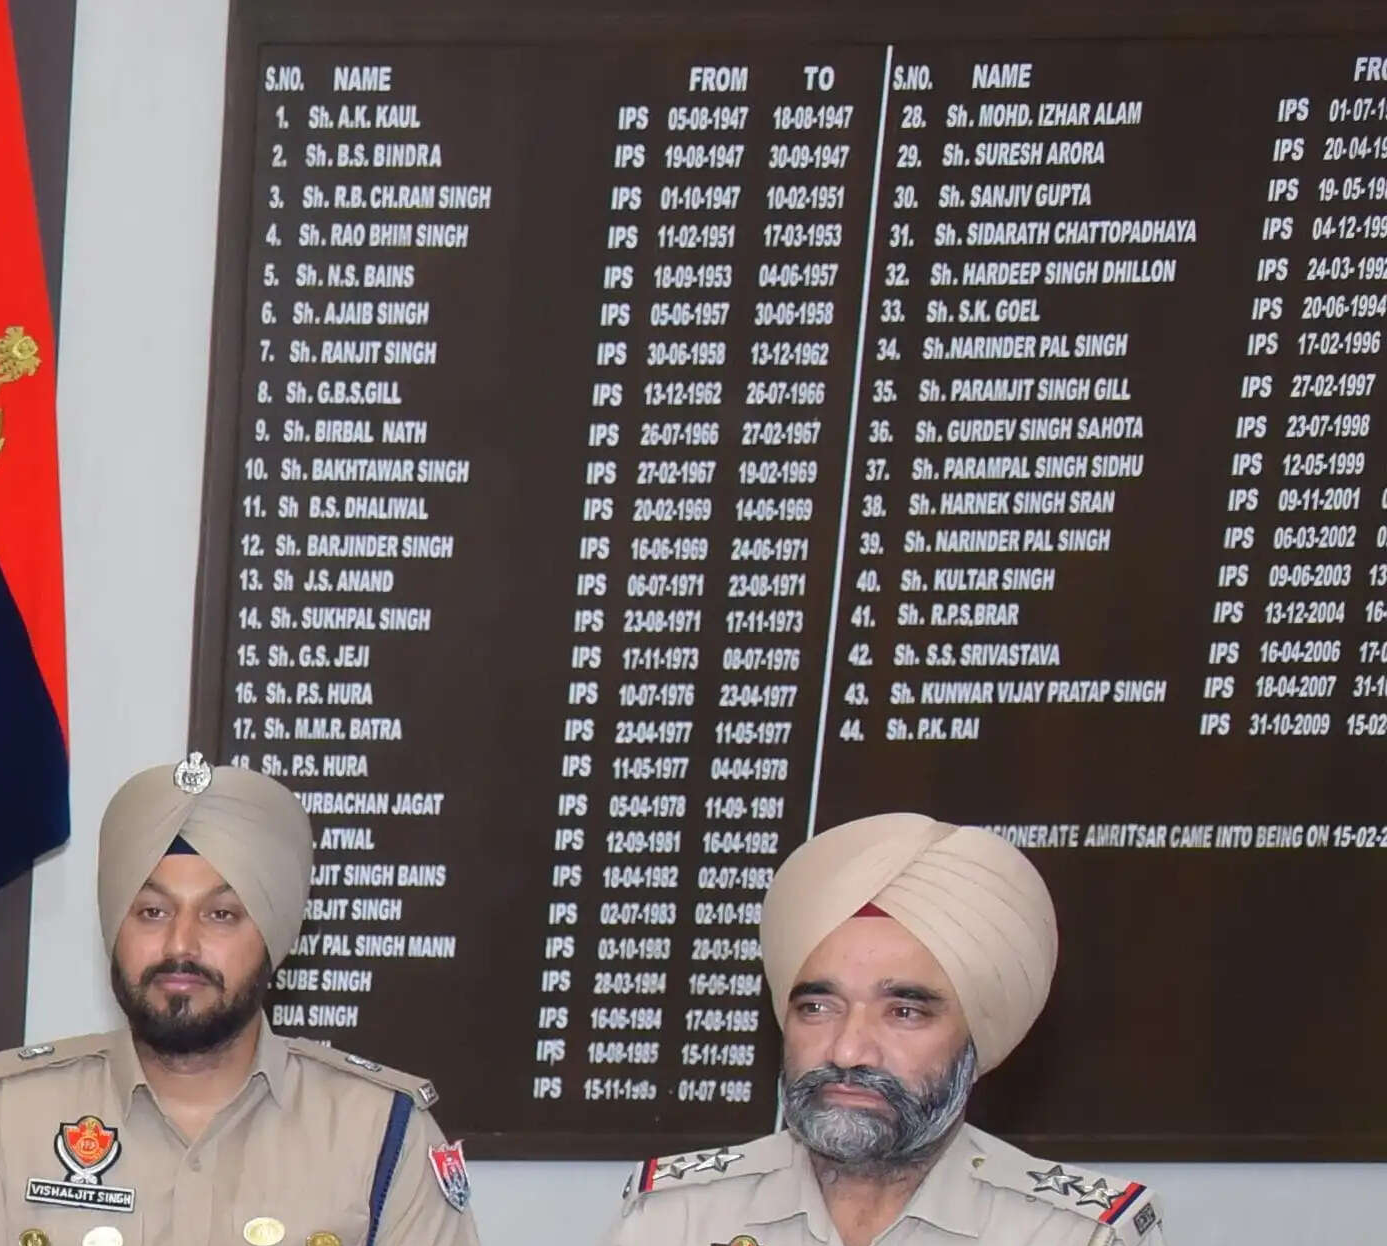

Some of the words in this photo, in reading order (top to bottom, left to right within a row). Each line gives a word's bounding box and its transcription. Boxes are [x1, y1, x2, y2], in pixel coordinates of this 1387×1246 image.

[264, 66, 304, 90] S.NO.
[333, 66, 391, 90] NAME
[689, 66, 748, 91] FROM
[804, 66, 834, 90] TO
[892, 65, 932, 90] S.NO.
[972, 63, 1032, 88] NAME
[275, 105, 288, 128] 1.
[308, 105, 333, 128] Sh.
[337, 104, 371, 128] A.K.
[375, 104, 420, 128] KAUL
[618, 106, 648, 129] IPS
[667, 106, 748, 130] 05-08-1947
[773, 105, 853, 129] 18-08-1947
[901, 104, 926, 128] 28.
[946, 104, 973, 127] Sh.
[978, 103, 1032, 127] MOHD.
[1037, 102, 1090, 126] IZHAR
[1093, 101, 1142, 125] ALAM
[1278, 97, 1308, 121] IPS
[268, 185, 284, 208] 3.
[302, 185, 329, 208] Sh.
[333, 185, 366, 208] R.B.
[369, 185, 435, 208] CH.RAM
[438, 185, 491, 208] SINGH
[611, 186, 641, 209] IPS
[660, 185, 740, 209] 01-10-1947
[766, 185, 844, 209] 10-02-1951
[889, 223, 913, 247] 31.
[934, 223, 962, 246] Sh.
[966, 221, 1050, 245] SIDARATH
[1054, 219, 1196, 244] CHATTOPADHAYA
[1262, 217, 1293, 240] IPS
[263, 263, 279, 286] 5.
[295, 262, 323, 286] Sh.
[327, 263, 359, 287] N.S.
[363, 264, 414, 287] BAINS
[603, 265, 633, 288] IPS
[653, 264, 731, 288] 18-09-1953
[758, 263, 838, 287] 04-06-1957
[259, 339, 274, 361] 7.
[289, 339, 316, 362] Sh.
[320, 340, 381, 363] RANJIT
[383, 340, 436, 364] SINGH
[596, 342, 626, 364] IPS
[646, 342, 725, 365] 30-06-1958
[751, 342, 828, 365] 13-12-1962
[872, 379, 896, 402] 35.
[918, 379, 945, 401] Sh.
[950, 378, 1034, 401] PARAMJIT
[1036, 378, 1090, 400] SINGH
[1093, 378, 1130, 400] GILL
[1241, 375, 1272, 397] IPS
[1290, 373, 1376, 397] 27-02-1997
[255, 418, 269, 441] 9.
[283, 419, 310, 442] Sh.
[314, 419, 373, 442] BIRBAL
[382, 420, 427, 443] NATH
[588, 423, 619, 446] IPS
[640, 422, 719, 445] 26-07-1966
[741, 421, 820, 444] 27-02-1967
[244, 457, 268, 480] 10.
[280, 457, 307, 480] Sh.
[311, 458, 414, 481] BAKHTAWAR
[416, 459, 469, 482] SINGH
[586, 461, 616, 484] IPS
[636, 460, 716, 484] 27-02-1967
[738, 460, 817, 483] 19-02-1969
[865, 458, 889, 481] 37.
[911, 457, 939, 480] Sh.
[943, 456, 1030, 479] PARAMPAL
[1034, 455, 1087, 478] SINGH
[1091, 454, 1143, 477] SIDHU
[1231, 452, 1262, 475] IPS
[1282, 452, 1364, 475] 12-05-1999
[240, 534, 264, 556] 12.
[275, 533, 301, 556] Sh.
[306, 534, 398, 557] BARJINDER
[401, 535, 453, 557] SINGH
[579, 536, 609, 559] IPS
[631, 537, 708, 560] 16-06-1969
[730, 538, 808, 560] 24-06-1971
[856, 570, 880, 591] 40.
[900, 569, 927, 591] Sh.
[933, 568, 999, 590] KULTAR
[1001, 567, 1055, 590] SINGH
[1218, 564, 1248, 586] IPS
[1269, 564, 1351, 586] 09-06-2003
[238, 607, 261, 629] 14.
[270, 606, 297, 628] Sh.
[301, 606, 375, 629] SUKHPAL
[378, 607, 430, 630] SINGH
[574, 609, 603, 632] IPS
[623, 609, 701, 632] 23-08-1971
[726, 609, 803, 632] 17-11-1973
[235, 681, 257, 703] 16.
[265, 681, 292, 704] Sh.
[295, 681, 323, 704] P.S.
[327, 682, 372, 704] HURA
[568, 681, 598, 704] IPS
[618, 683, 694, 706] 10-07-1976
[719, 684, 797, 707] 23-04-1977
[844, 683, 868, 705] 43.
[890, 682, 914, 704] Sh.
[921, 681, 993, 704] KUNWAR
[997, 681, 1044, 703] VIJAY
[1047, 680, 1110, 702] PRATAP
[1113, 680, 1166, 702] SINGH
[1204, 676, 1234, 698] IPS
[1256, 675, 1336, 697] 18-04-2007
[319, 828, 374, 849] ATWAL
[554, 828, 584, 850] IPS
[702, 831, 778, 853] 16-04-1982
[1084, 824, 1166, 848] AMRITSAR
[1170, 825, 1213, 847] CAME
[1215, 825, 1252, 847] INTO
[1255, 825, 1303, 847] BEING
[1306, 824, 1329, 846] ON
[276, 969, 318, 990] SUBE
[321, 969, 372, 991] SINGH
[541, 970, 570, 991] IPS
[272, 1006, 304, 1027] BUA
[307, 1004, 358, 1026] SINGH
[538, 1006, 568, 1028] IPS
[31, 1183, 95, 1201] VISHALJIT
[97, 1191, 131, 1204] SINGH
